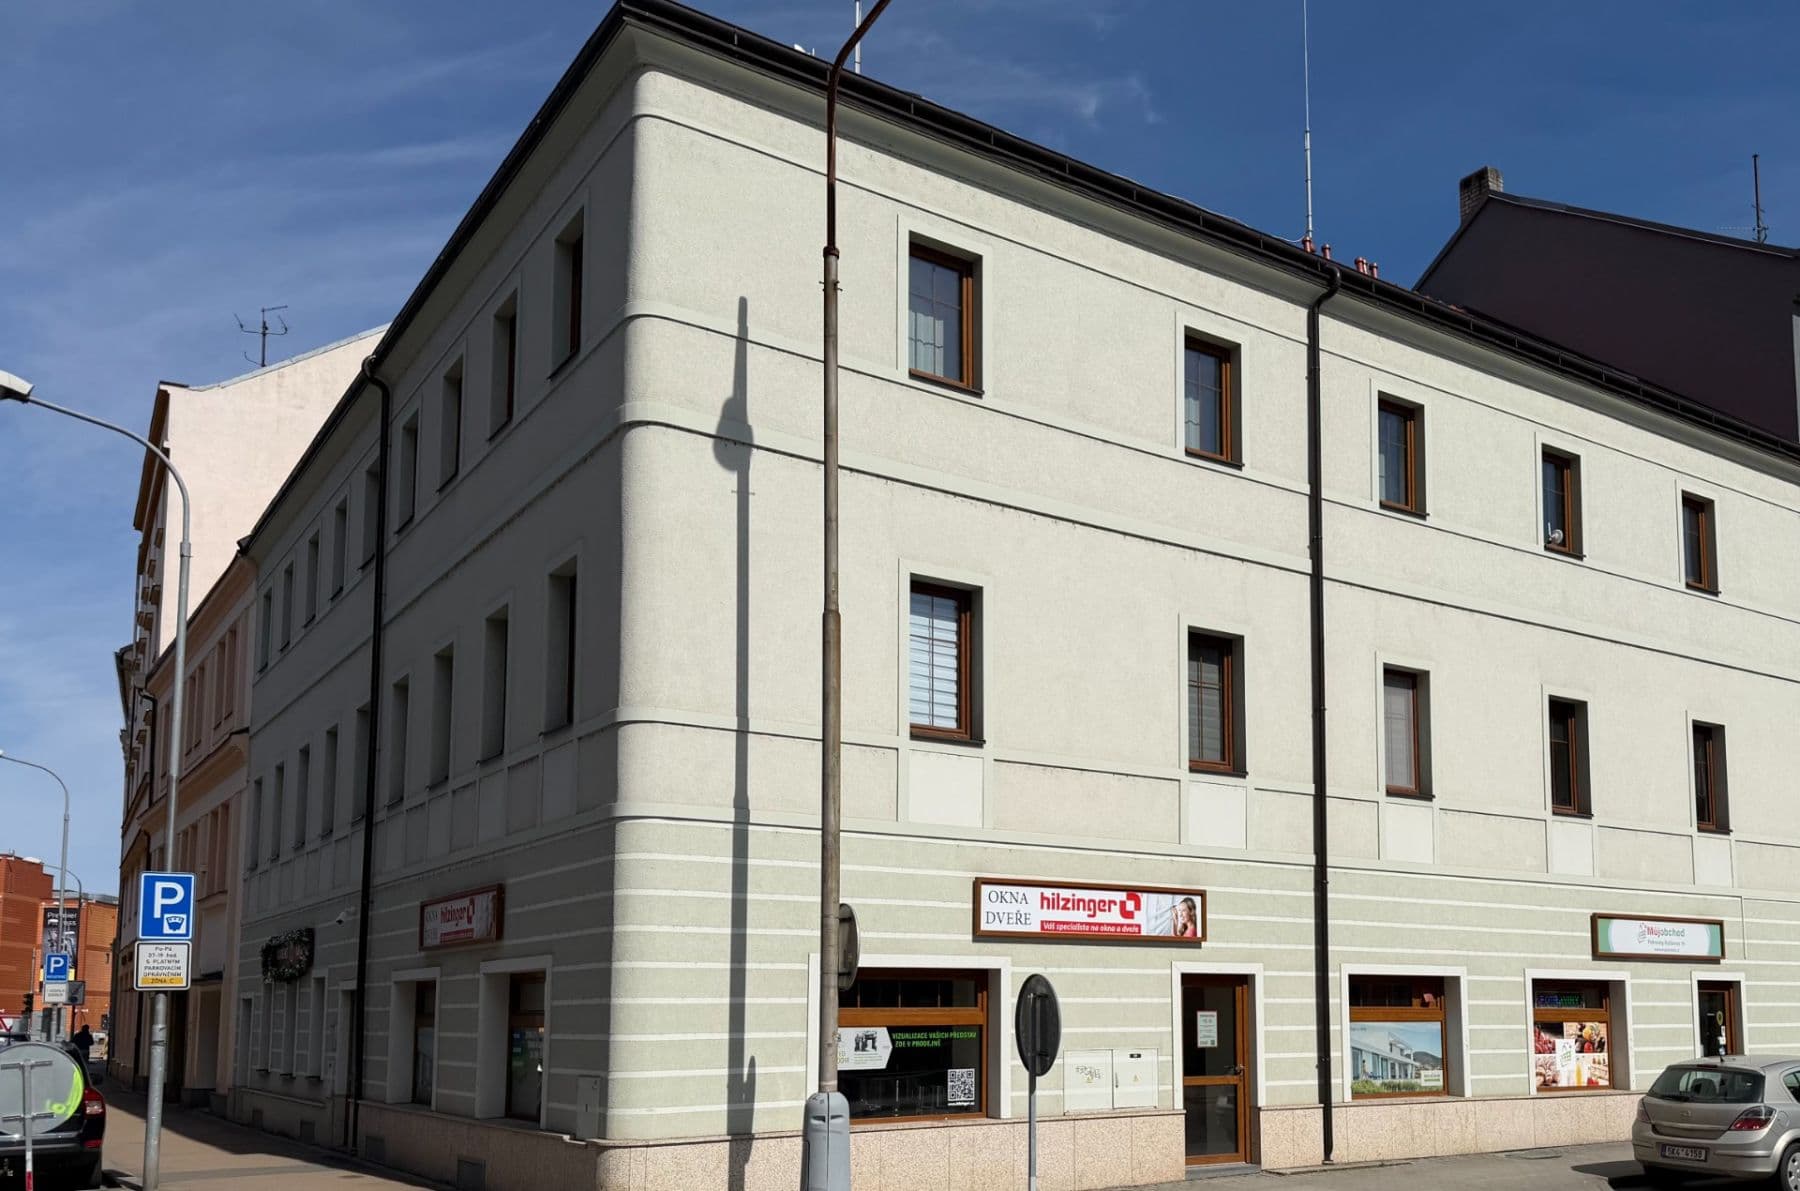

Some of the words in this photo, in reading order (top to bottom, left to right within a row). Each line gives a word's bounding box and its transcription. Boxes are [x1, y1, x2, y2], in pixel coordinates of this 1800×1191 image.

[153, 881, 185, 919] P
[988, 890, 1029, 905] OKNA
[1040, 891, 1118, 918] hilzinger
[985, 909, 1032, 926] DVEŘE
[1043, 921, 1055, 930] Váš
[1100, 924, 1115, 932] okna
[50, 956, 65, 973] P
